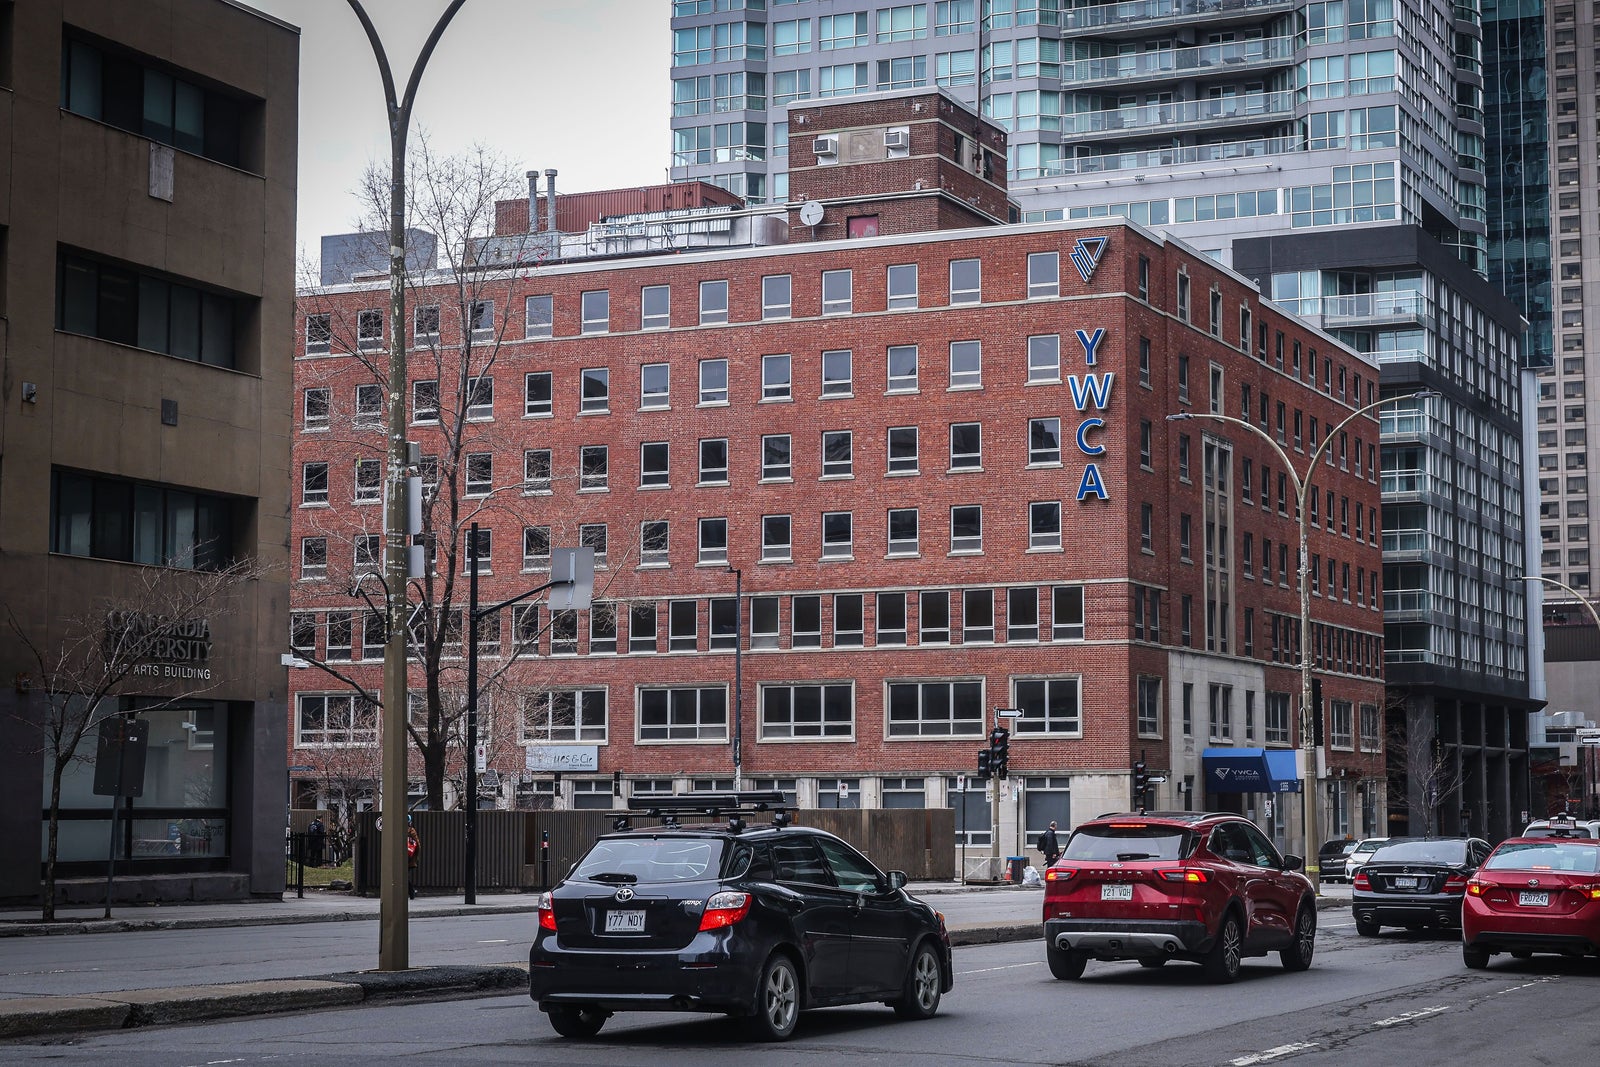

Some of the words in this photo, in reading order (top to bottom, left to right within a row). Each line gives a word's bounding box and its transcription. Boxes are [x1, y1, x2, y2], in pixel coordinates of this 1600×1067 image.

[1067, 327, 1116, 501] YWCA
[104, 662, 129, 674] FE
[133, 664, 159, 676] ARTS
[164, 666, 211, 680] BUILDING
[1103, 888, 1115, 896] Y21
[608, 915, 623, 926] Y77
